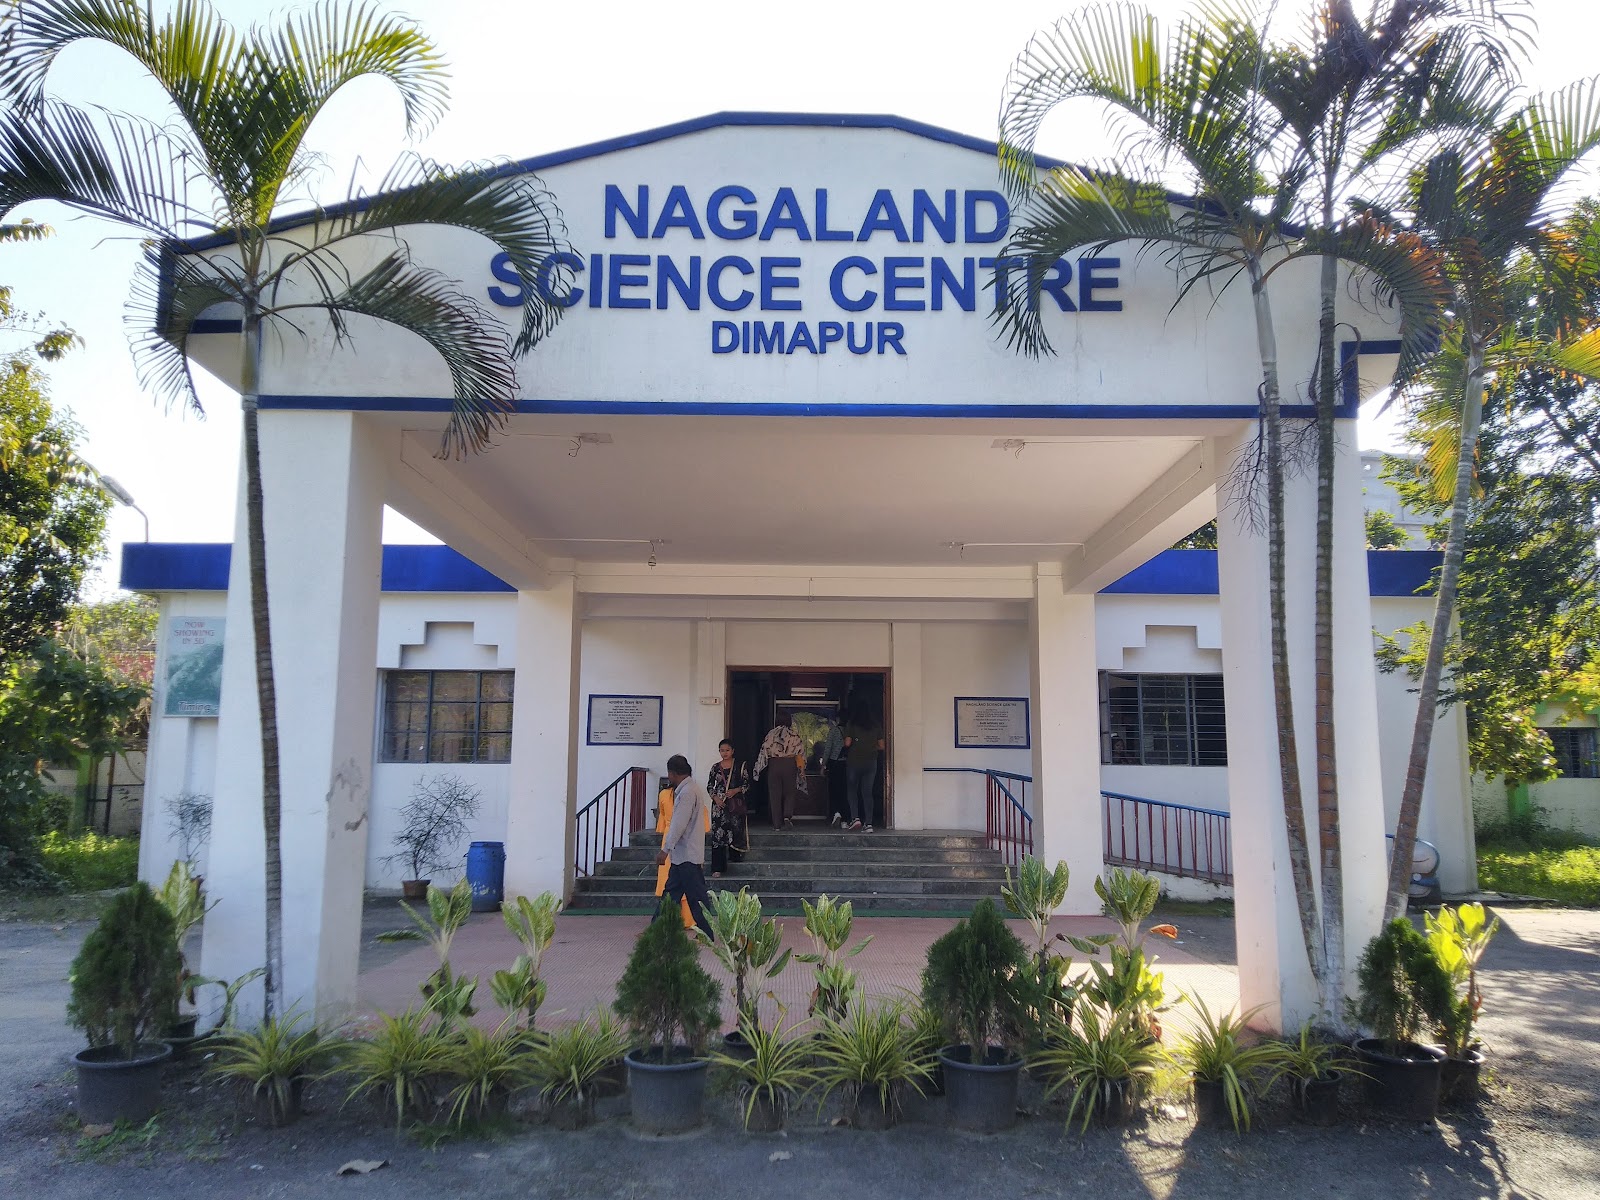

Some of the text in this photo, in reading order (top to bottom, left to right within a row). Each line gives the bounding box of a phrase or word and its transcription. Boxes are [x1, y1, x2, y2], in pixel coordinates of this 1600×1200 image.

[603, 184, 1010, 244] NAGALAND
[488, 251, 1121, 312] SCIENCE CENTRE
[711, 320, 906, 355] DIMAPUR
[174, 629, 215, 637] SHOWING
[184, 621, 205, 629] NOW
[178, 701, 212, 713] Timing
